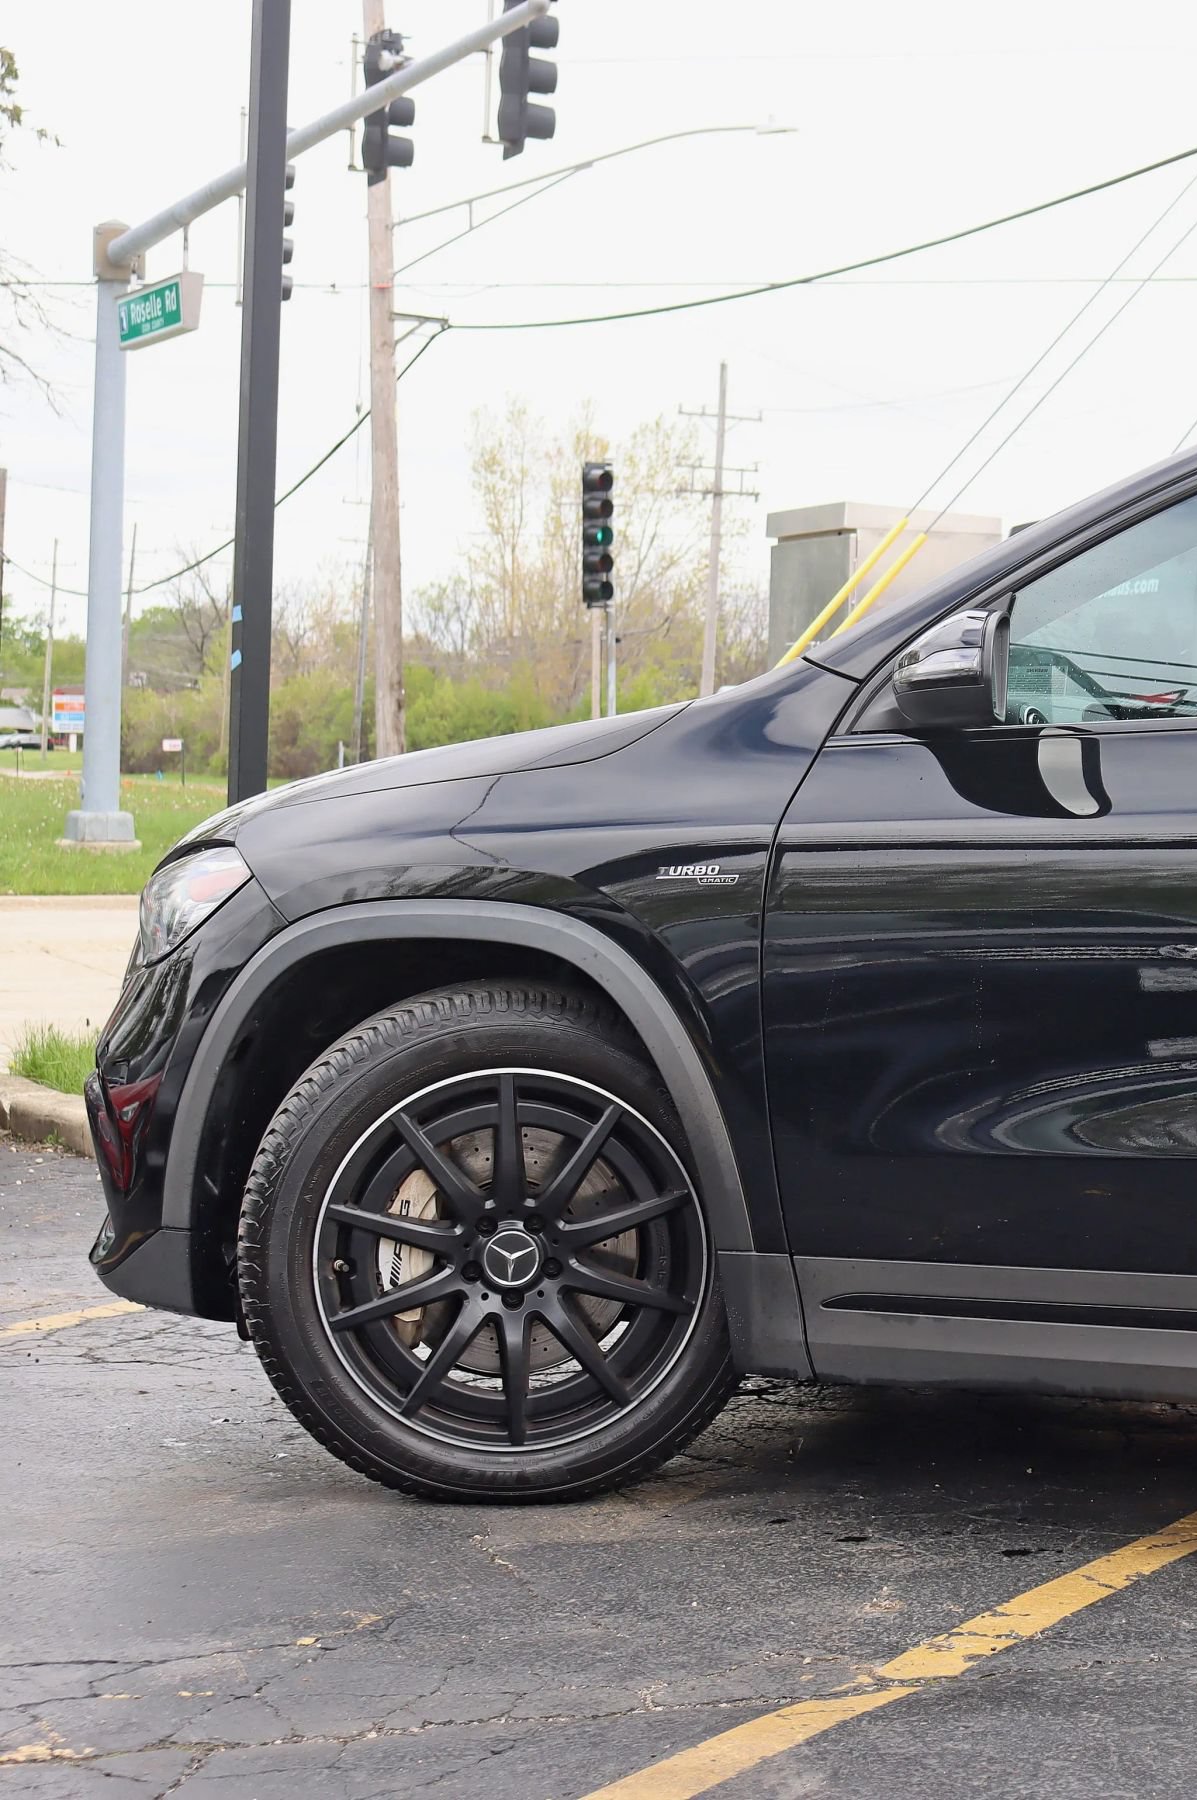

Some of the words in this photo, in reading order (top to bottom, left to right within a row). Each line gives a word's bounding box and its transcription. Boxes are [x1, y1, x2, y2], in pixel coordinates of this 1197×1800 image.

[130, 292, 162, 327] Roselle
[164, 284, 177, 314] Rd
[658, 865, 720, 876] TURBO
